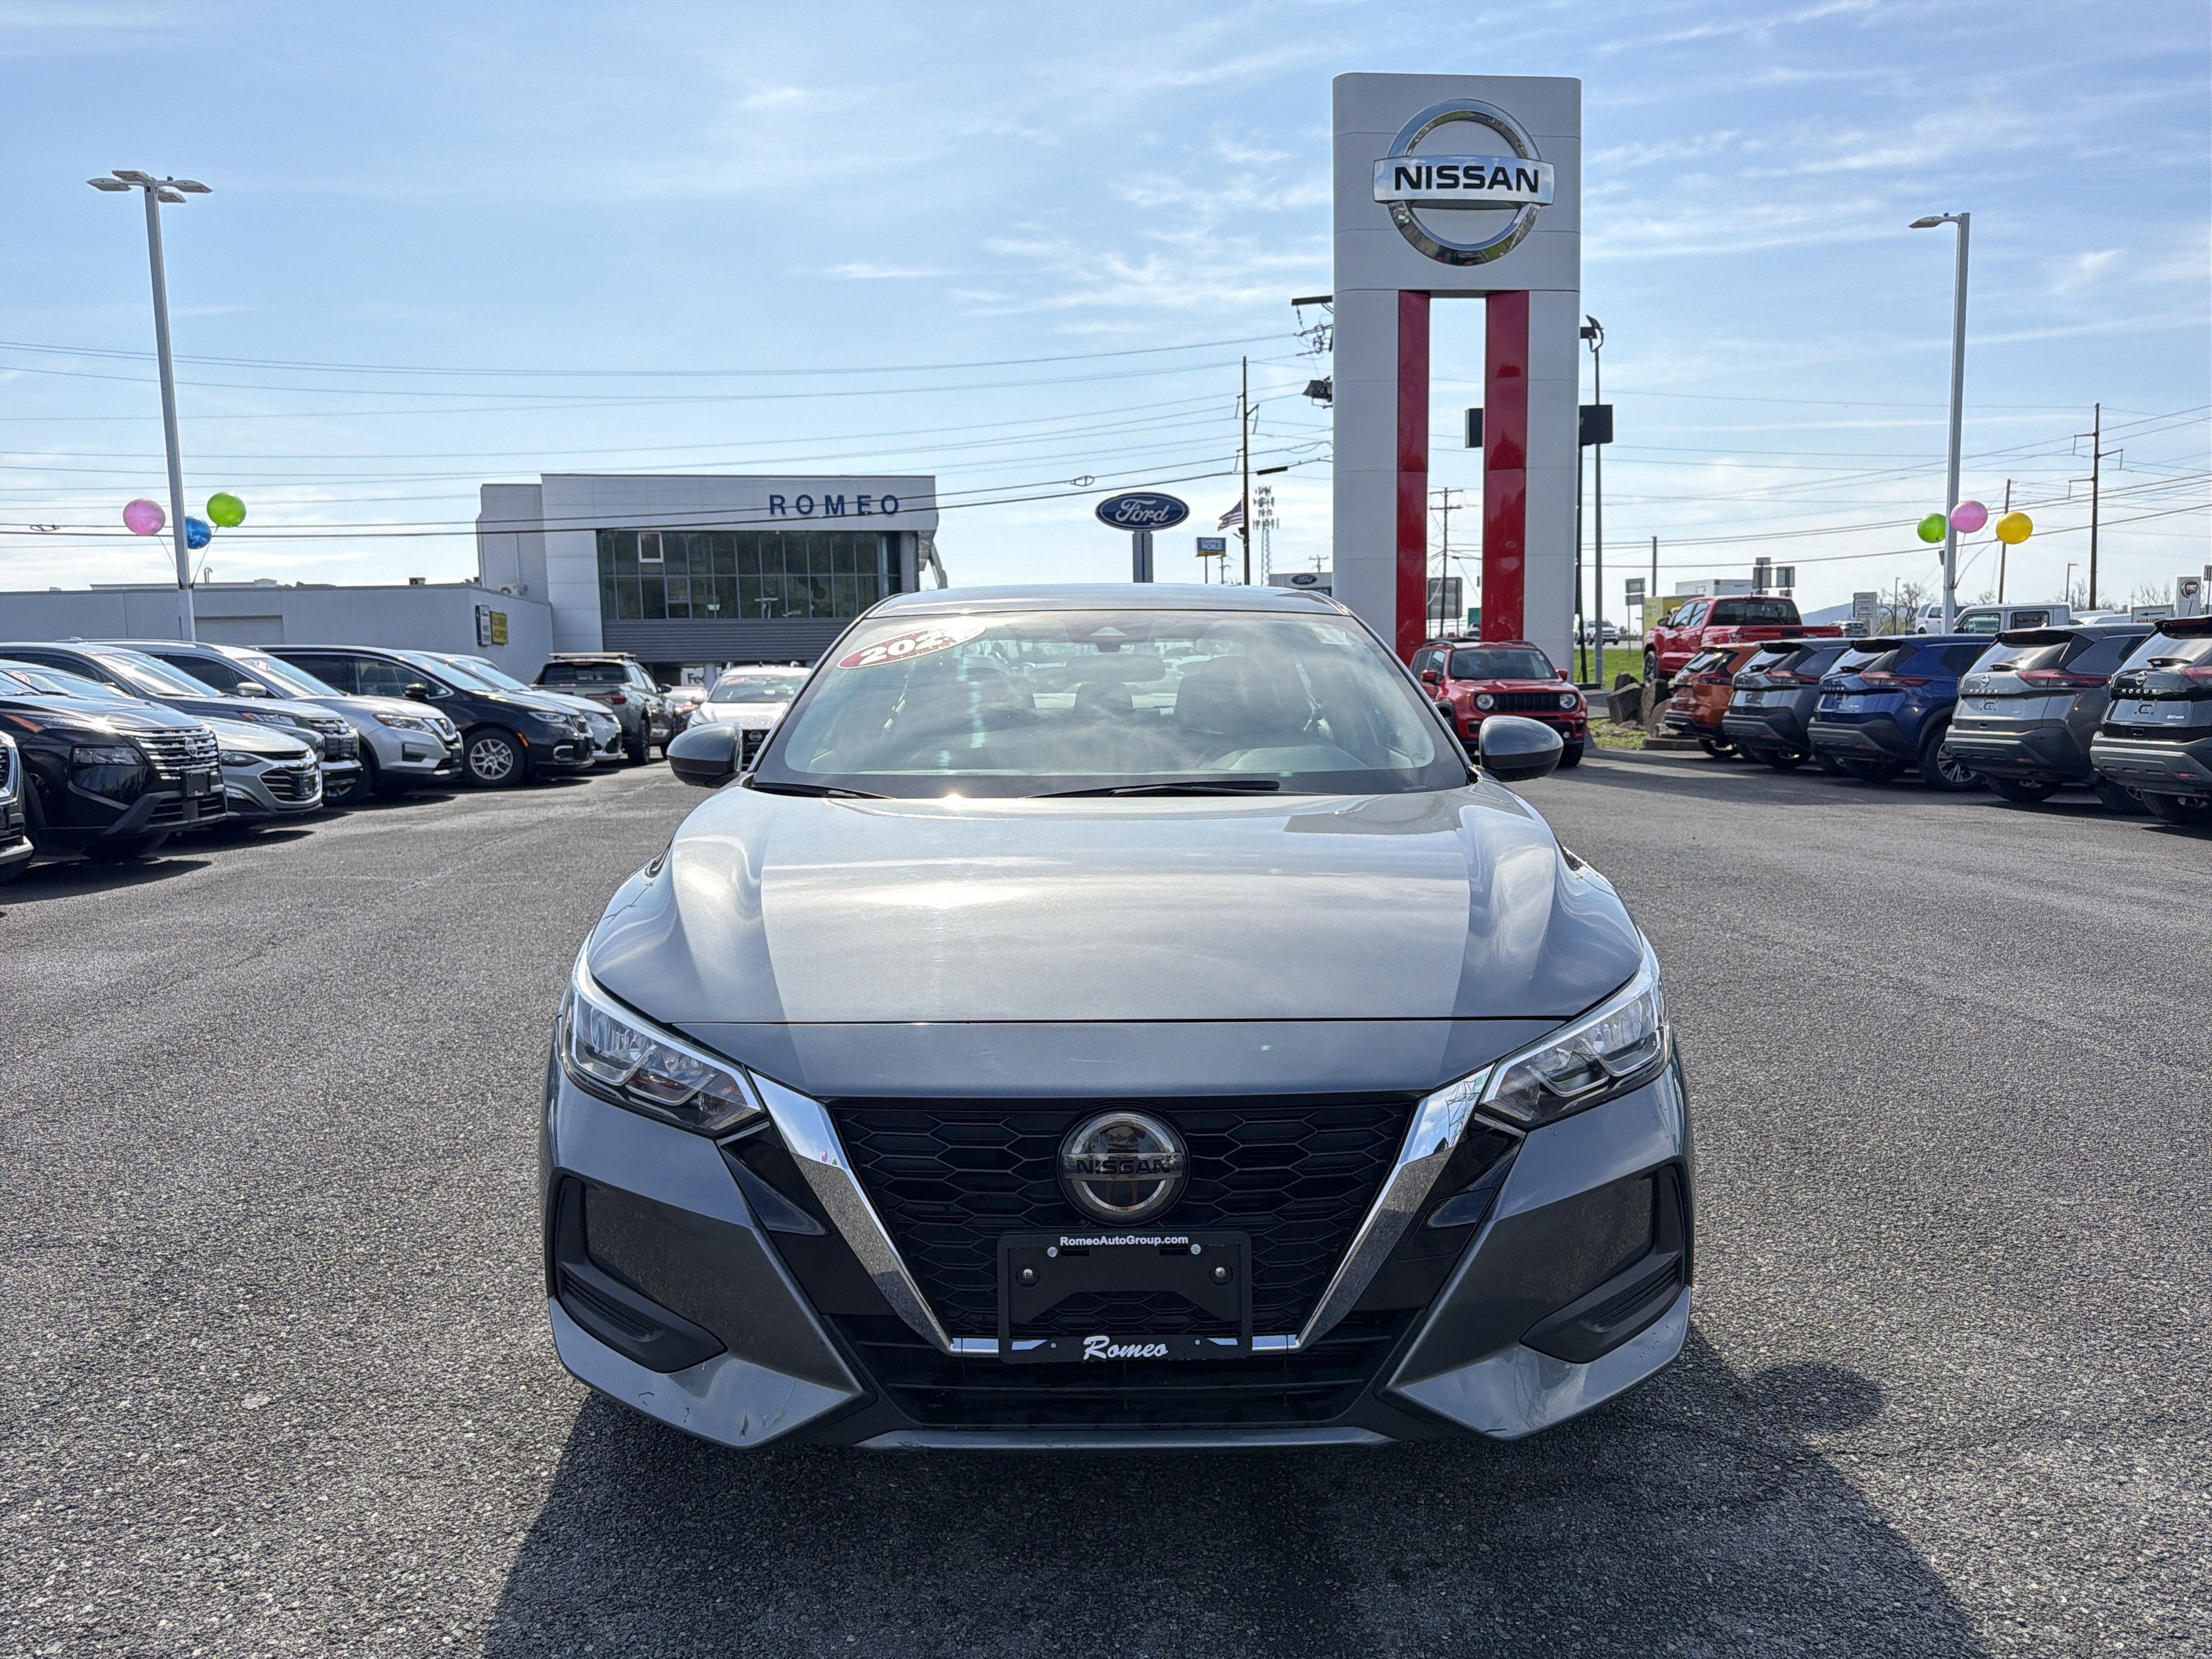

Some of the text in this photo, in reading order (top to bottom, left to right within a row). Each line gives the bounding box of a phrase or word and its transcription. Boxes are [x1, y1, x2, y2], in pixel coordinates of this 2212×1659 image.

[1395, 165, 1539, 193] NISSAN
[769, 494, 899, 515] ROMEO
[1115, 498, 1170, 522] Ford
[1076, 1158, 1171, 1175] NISSAN
[1060, 1235, 1189, 1246] RomeoAutoGroup.com
[1083, 1335, 1169, 1361] Romeo
